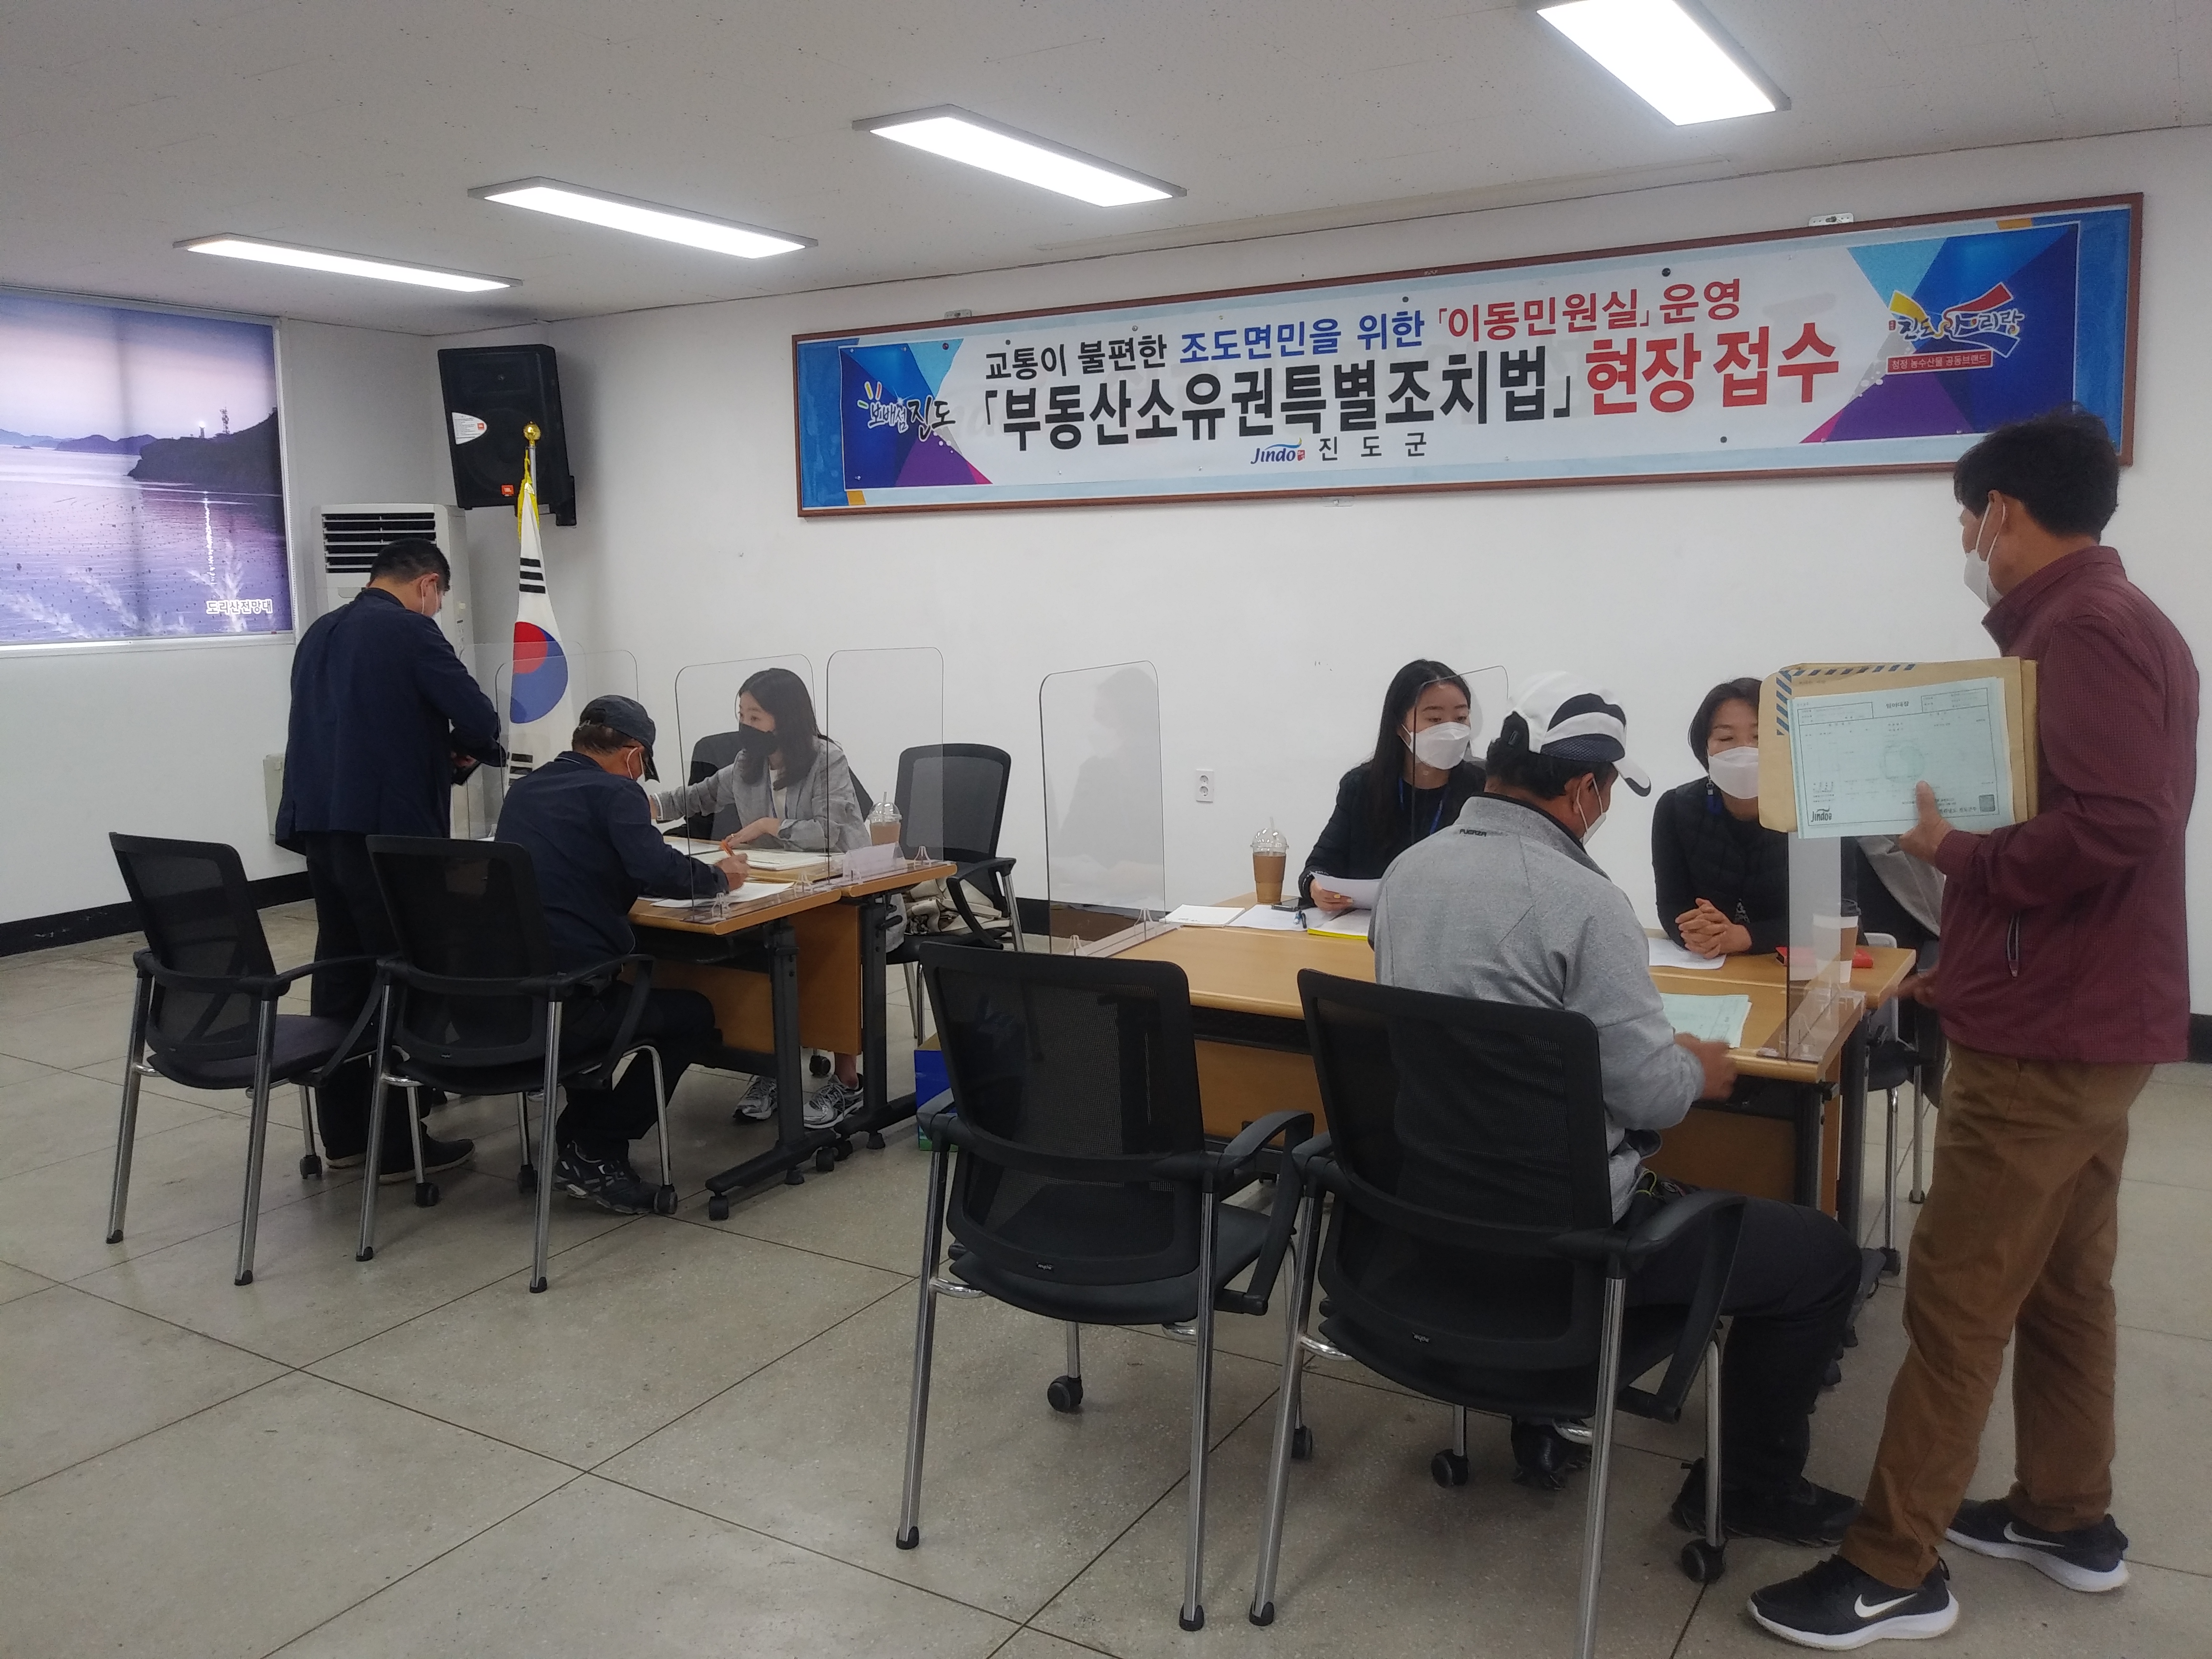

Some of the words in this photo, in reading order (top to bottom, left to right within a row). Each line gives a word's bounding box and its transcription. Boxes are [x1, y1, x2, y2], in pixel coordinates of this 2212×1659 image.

[985, 343, 1067, 380] 교통이
[1077, 334, 1167, 375] 불편한
[1180, 318, 1341, 363] 조도면민을
[1358, 310, 1424, 350] 위한
[1659, 278, 1739, 324] 운영
[1892, 359, 1908, 369] 청정
[1910, 357, 1944, 369] 농수산물
[1946, 353, 1987, 366] 공동브랜드
[984, 345, 1571, 451] 「부동산소유권특별조치법」
[868, 401, 908, 433] 보배섬
[907, 395, 956, 441] 진도
[1250, 447, 1296, 464] Jindo
[207, 600, 272, 614] 도리산전망대
